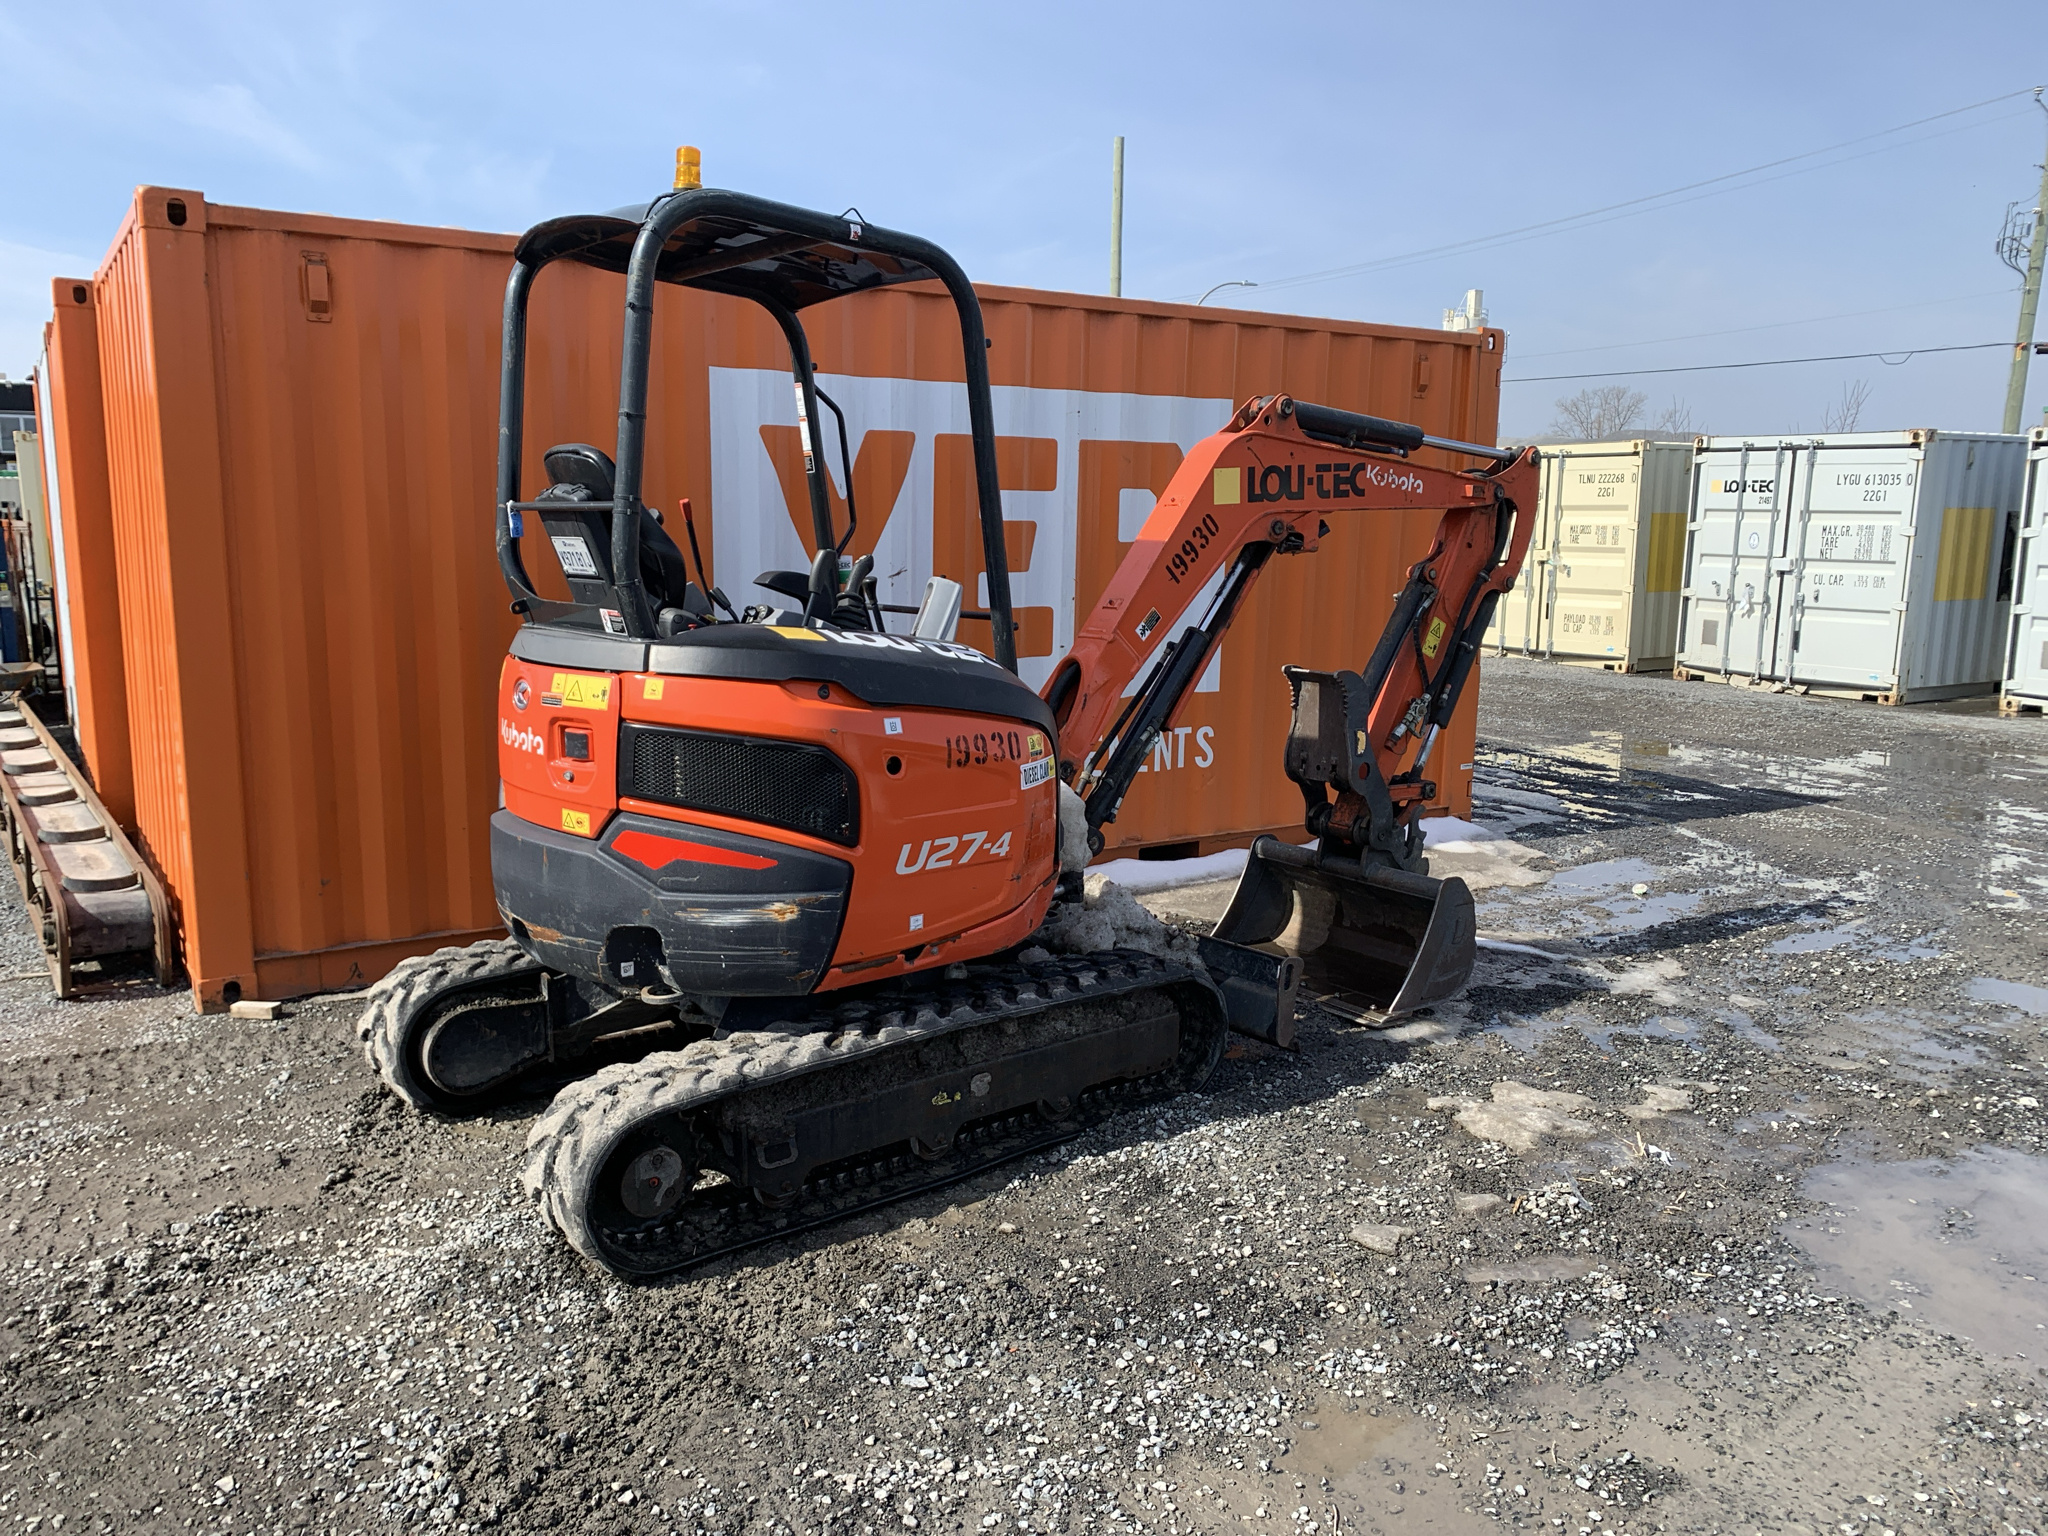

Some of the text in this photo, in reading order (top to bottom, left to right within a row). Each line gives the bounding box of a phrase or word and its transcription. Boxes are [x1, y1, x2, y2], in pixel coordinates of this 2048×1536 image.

[1366, 464, 1424, 494] Kubota
[1579, 473, 1596, 484] TLNU
[1598, 472, 1625, 484] 222268
[1836, 473, 1913, 486] LYGU 613035 0
[1597, 486, 1615, 498] 22G1
[1863, 489, 1888, 502] 22G1
[1821, 525, 1853, 537] MAX.GR.
[1569, 534, 1580, 545] TARE
[1821, 537, 1839, 548] TARE
[1165, 513, 1220, 585] 19930
[1820, 548, 1833, 560] NET
[1828, 574, 1844, 586] CAP.
[501, 717, 545, 756] Kubota
[945, 731, 1021, 769] 19930
[895, 830, 1012, 875] U27-4
